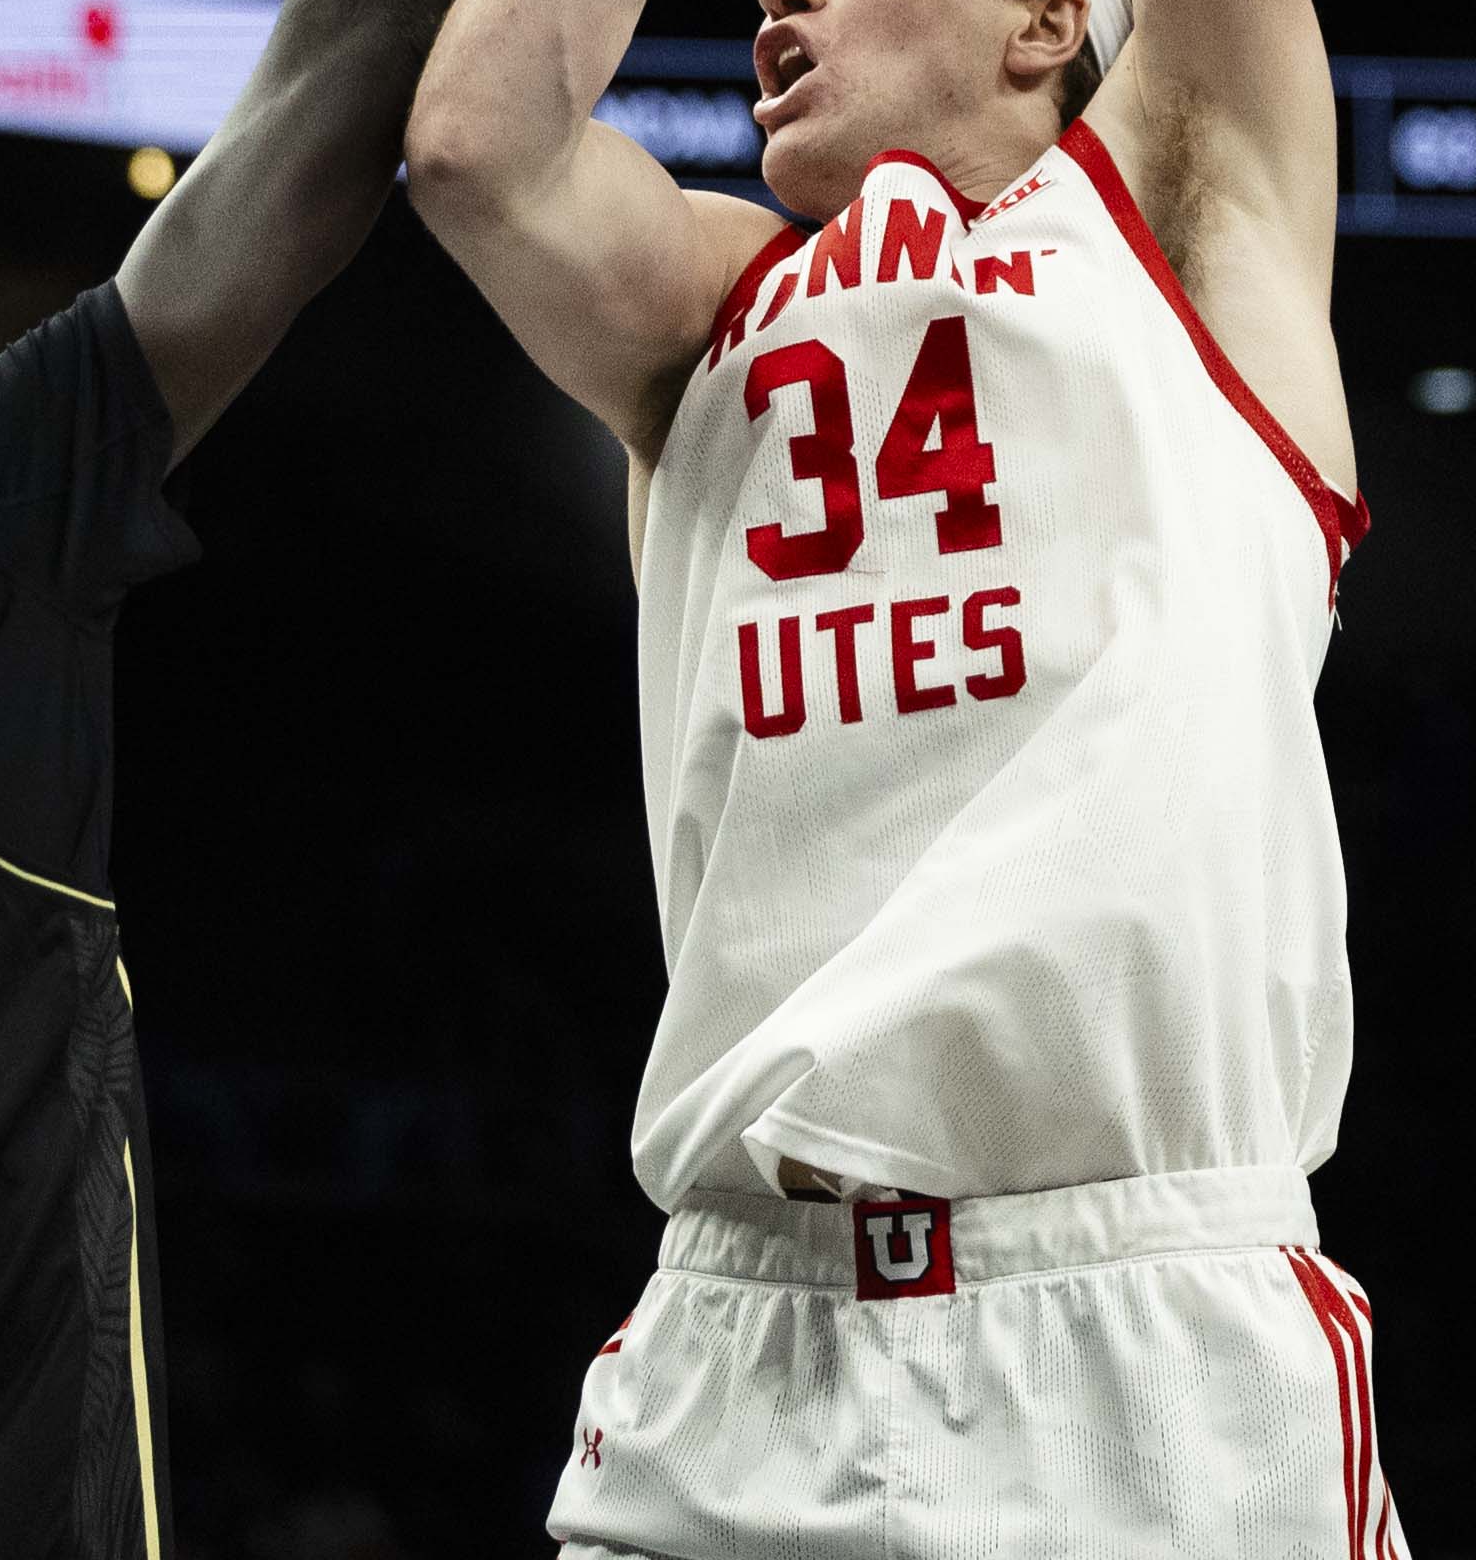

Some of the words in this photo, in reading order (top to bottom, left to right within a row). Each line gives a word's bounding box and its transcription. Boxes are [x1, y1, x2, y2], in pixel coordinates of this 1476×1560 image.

[743, 314, 1003, 581] 34
[737, 585, 1028, 740] UTES
[863, 1208, 933, 1285] U
